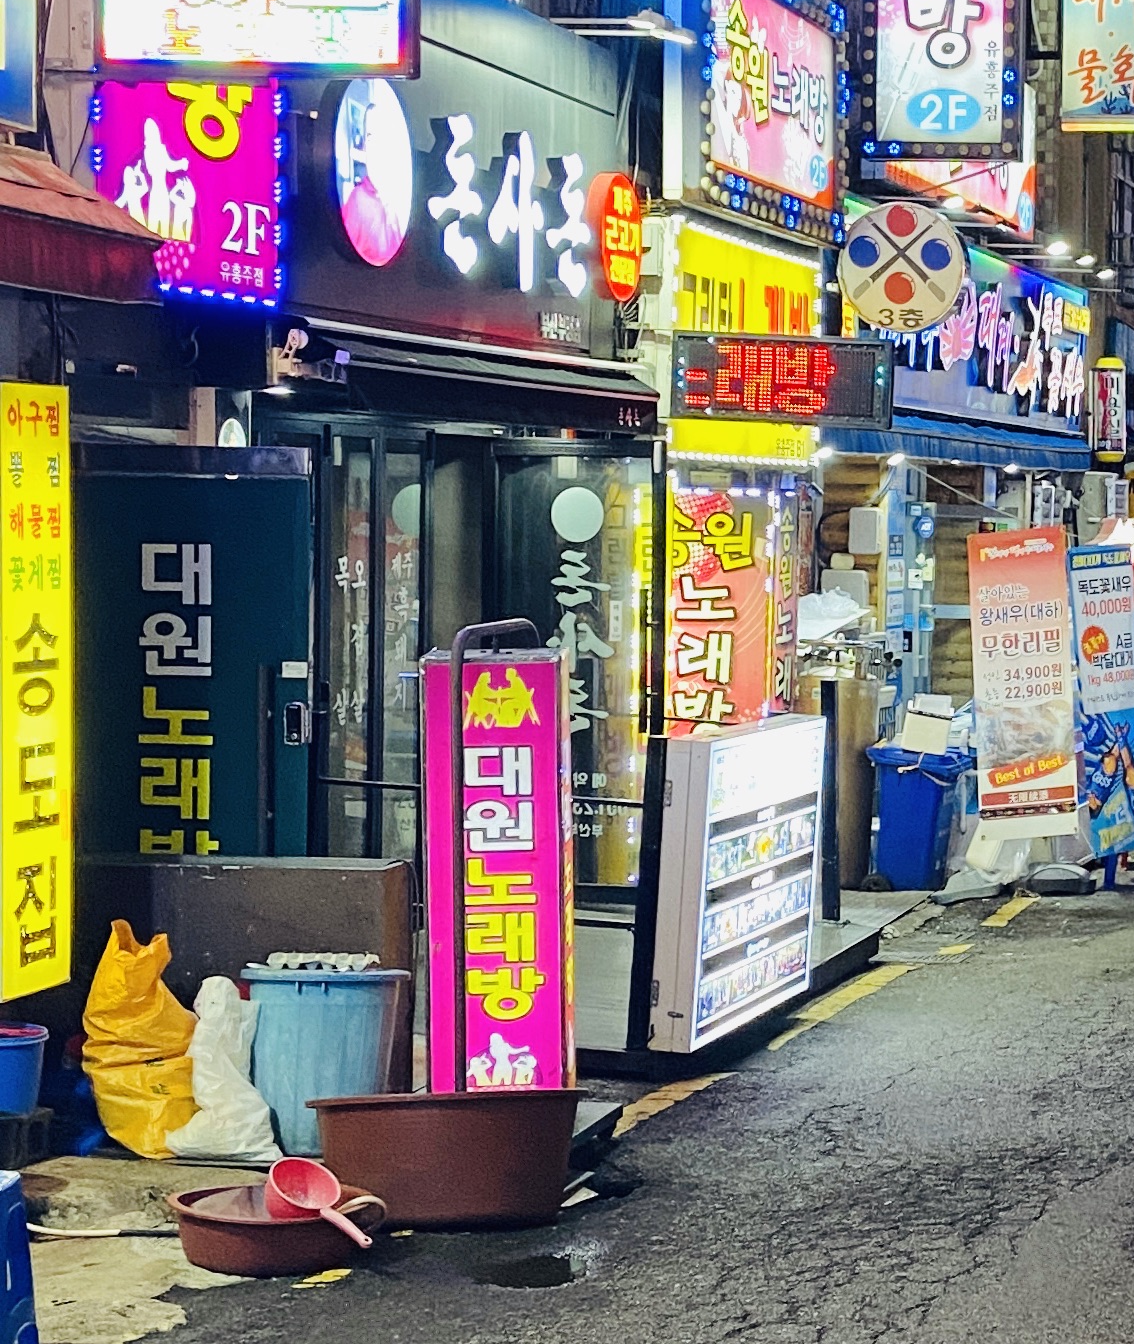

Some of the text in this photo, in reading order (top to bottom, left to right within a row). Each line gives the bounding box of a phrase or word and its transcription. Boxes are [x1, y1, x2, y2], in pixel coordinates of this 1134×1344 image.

[983, 39, 1001, 123] 유흥주점
[917, 91, 967, 132] 2F
[811, 159, 827, 189] 2F
[221, 201, 271, 254] 2F
[604, 215, 640, 257] 근고기
[219, 259, 265, 287] 유흥주점
[878, 307, 924, 330] 3층
[7, 398, 61, 437] 아구찜
[1104, 375, 1121, 439] 미용실
[9, 502, 62, 540] 해물찜
[8, 553, 62, 592] 꽃게찜
[978, 584, 1030, 602] 살아있는
[1080, 597, 1134, 618] 40,000원
[979, 600, 1064, 628] 왕새우(대하)
[980, 627, 1063, 661] 무한리필
[1003, 662, 1063, 684] 34,900원
[1087, 673, 1101, 687] 1kg
[1004, 680, 1063, 700] 22,900원
[994, 753, 1064, 785] Best of Best
